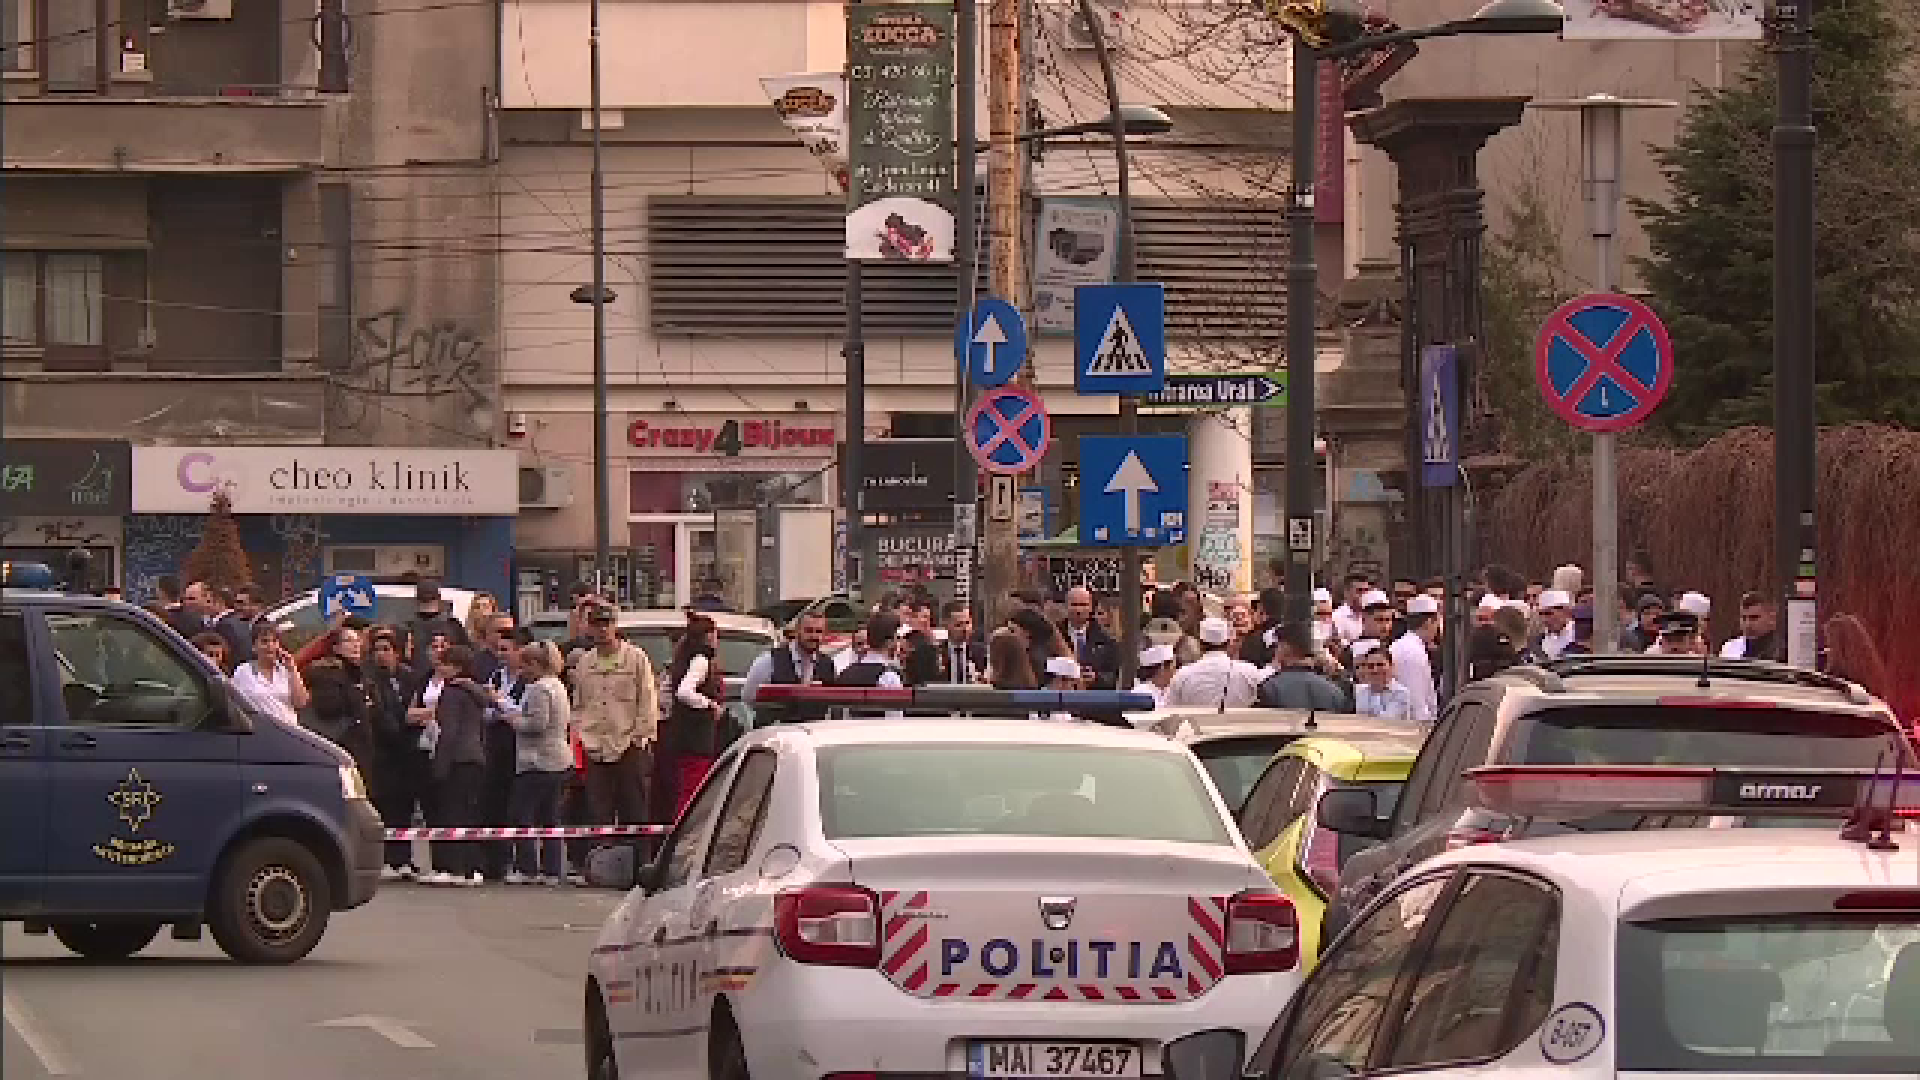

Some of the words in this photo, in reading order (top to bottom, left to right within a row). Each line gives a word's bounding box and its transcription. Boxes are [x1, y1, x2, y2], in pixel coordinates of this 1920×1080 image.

[268, 459, 353, 490] cheo
[369, 461, 471, 490] klinik
[941, 938, 1183, 978] POLITIA
[989, 1046, 1033, 1075] MAI
[1046, 1046, 1132, 1075] 37467
